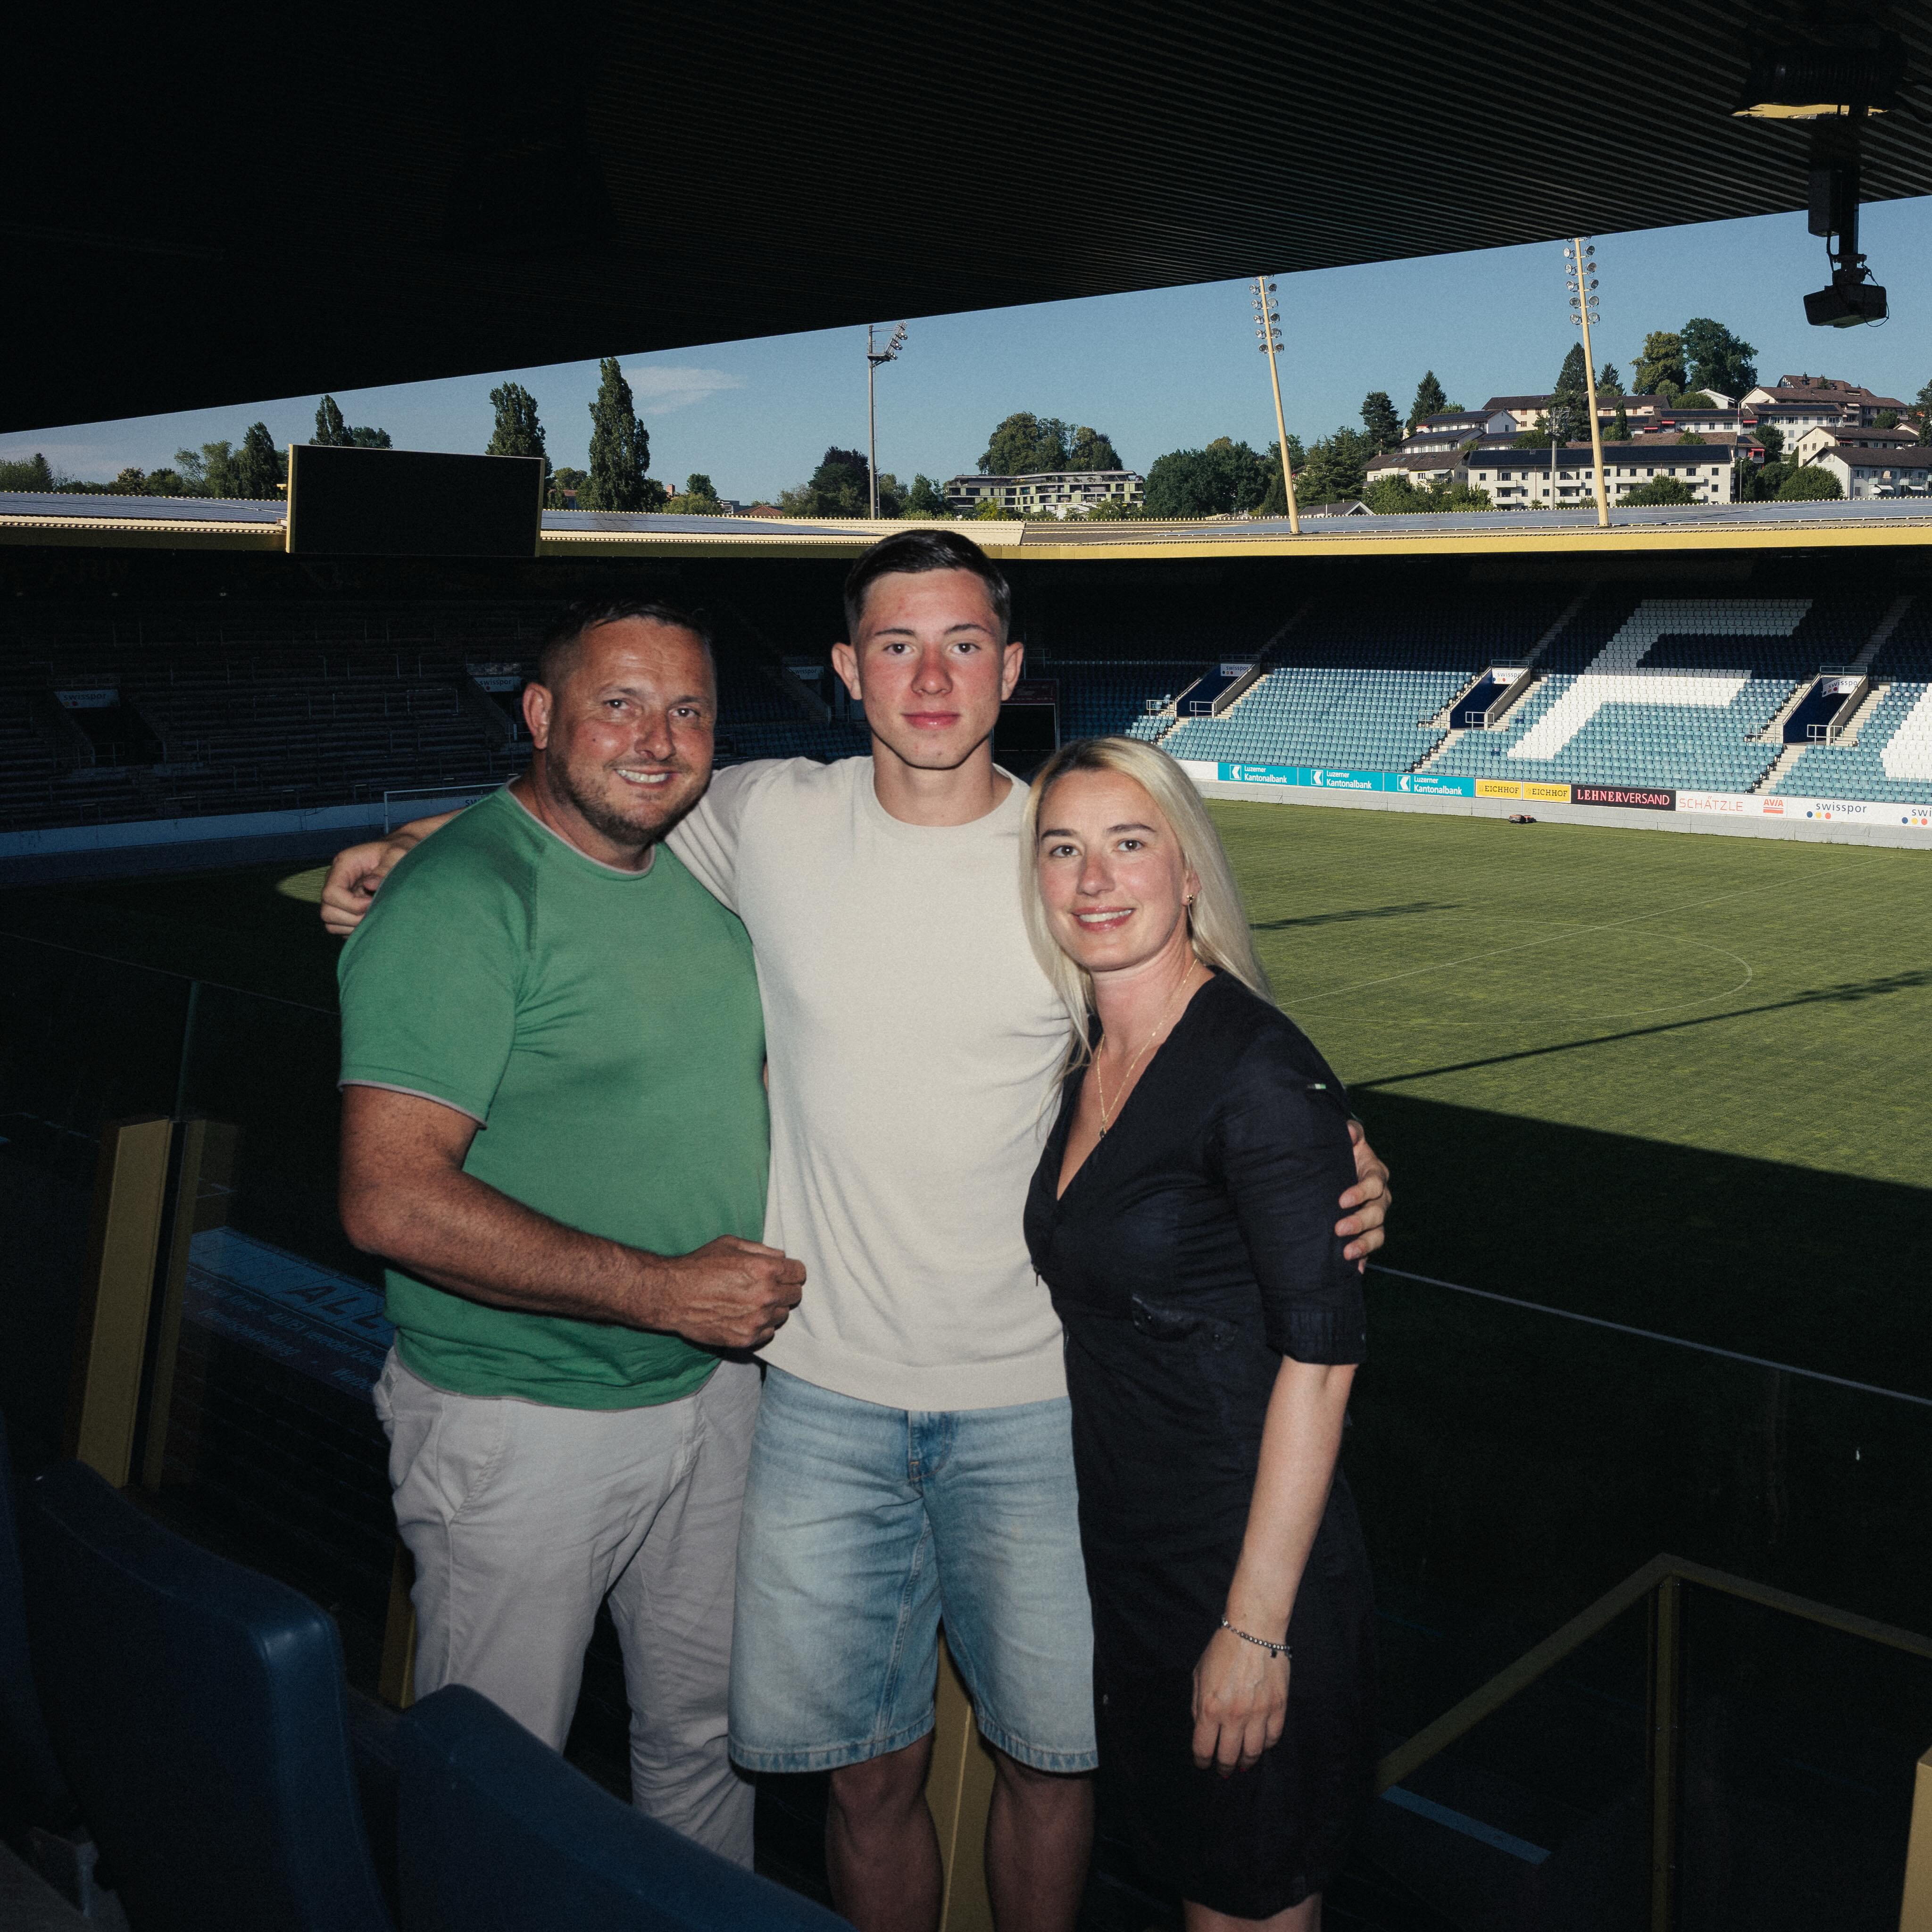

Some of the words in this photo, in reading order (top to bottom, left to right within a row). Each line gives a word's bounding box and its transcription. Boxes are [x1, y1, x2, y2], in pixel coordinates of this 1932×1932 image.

[1244, 773, 1287, 783] Kantonalbank
[1326, 770, 1350, 778] Luzerner
[1326, 778, 1372, 789] Kantonalbank
[1414, 776, 1439, 784] Luzerner
[1414, 784, 1462, 795] Kantonalbank
[1484, 785, 1519, 794] EICHHOF
[1532, 788, 1568, 797] EICHHOF
[1679, 796, 1743, 812] SCHÄTZLE
[1815, 801, 1867, 815] swisspor
